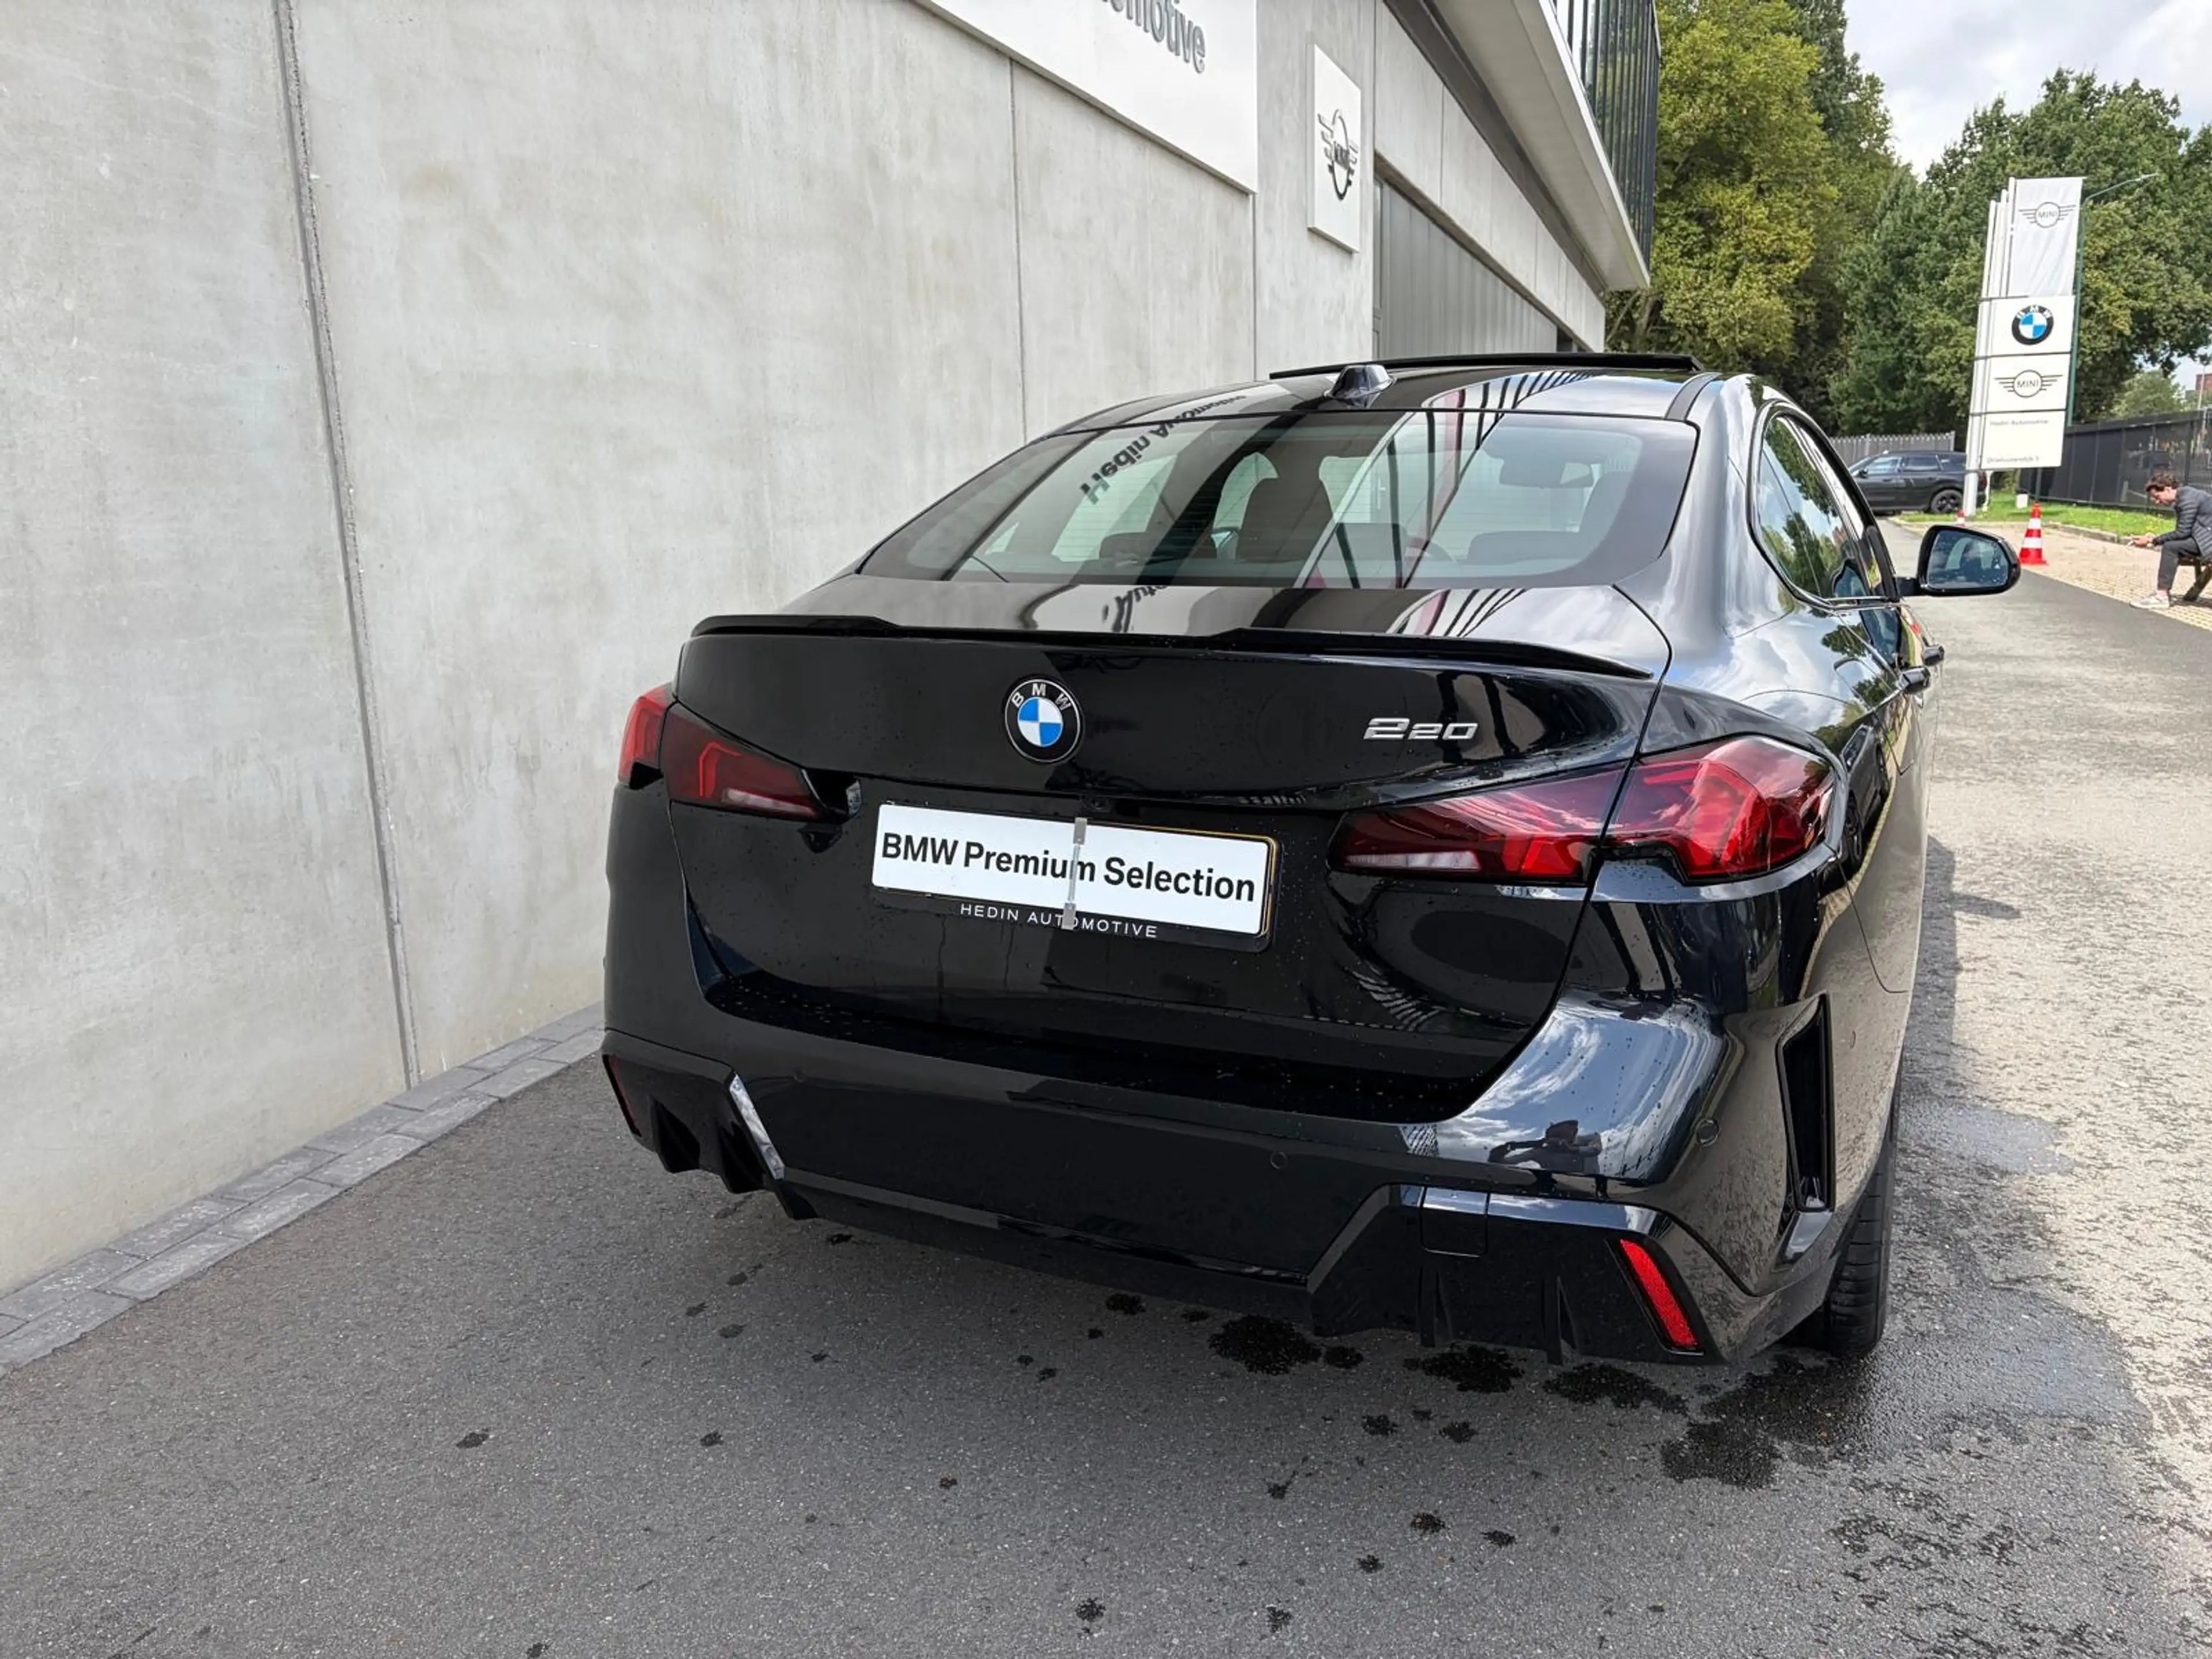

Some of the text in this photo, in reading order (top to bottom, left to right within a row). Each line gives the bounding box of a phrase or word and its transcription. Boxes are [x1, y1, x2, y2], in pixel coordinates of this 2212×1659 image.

[2017, 380, 2040, 388] MINI
[1011, 683, 1071, 711] BMW
[1363, 718, 1478, 740] 220
[882, 832, 1255, 902] BMW Premium Selection
[960, 903, 1019, 921] HEDIN
